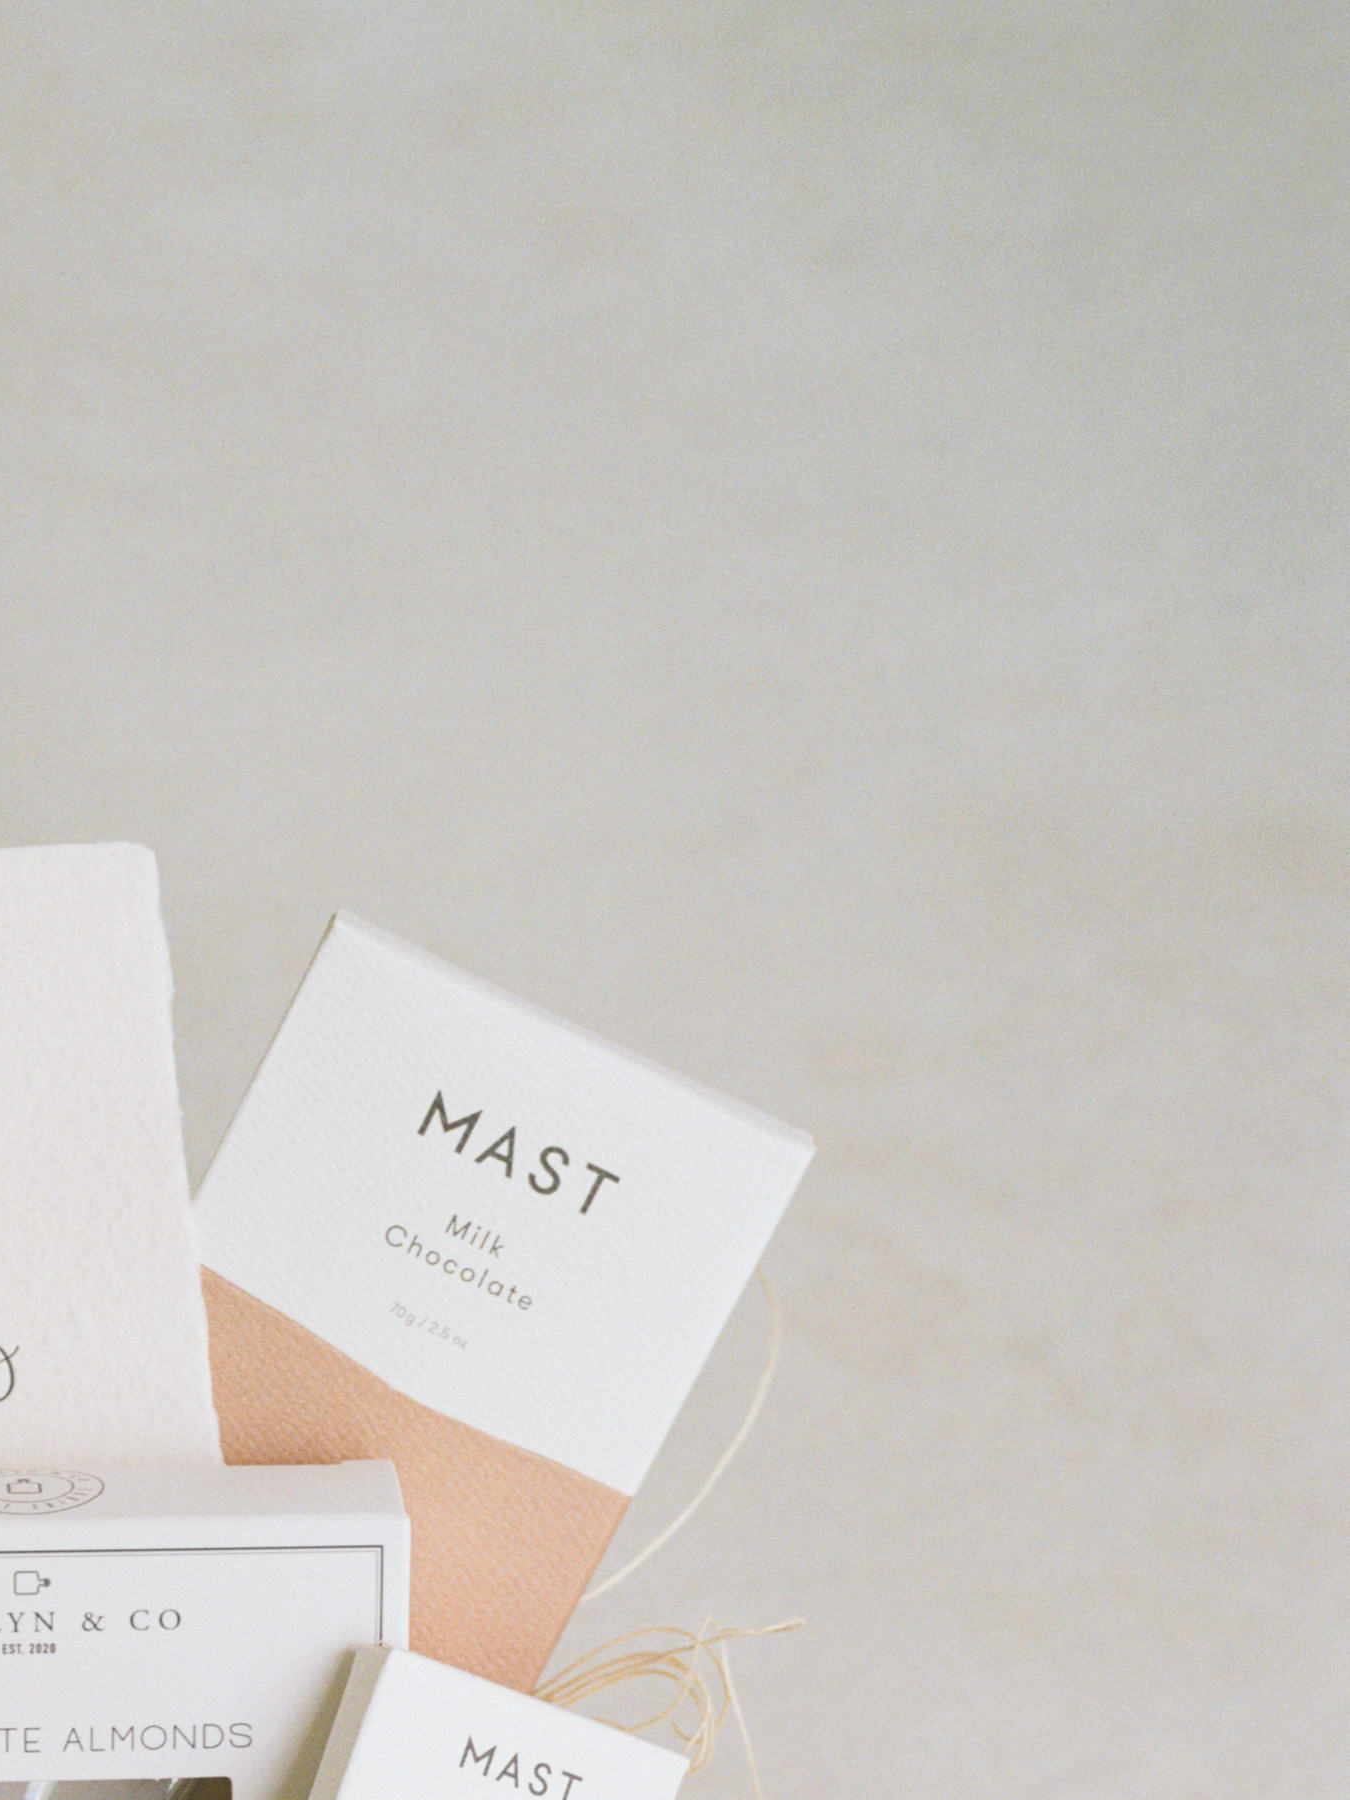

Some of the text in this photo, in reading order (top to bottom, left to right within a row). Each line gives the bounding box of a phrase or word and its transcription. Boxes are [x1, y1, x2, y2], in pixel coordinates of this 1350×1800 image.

[417, 1089, 620, 1215] MAST
[445, 1214, 505, 1258] Milk
[385, 1224, 533, 1310] Chocolate
[81, 1611, 105, 1632] &
[129, 1608, 182, 1631] CO
[29, 1642, 56, 1655] 2020
[62, 1722, 254, 1753] ALMONDS
